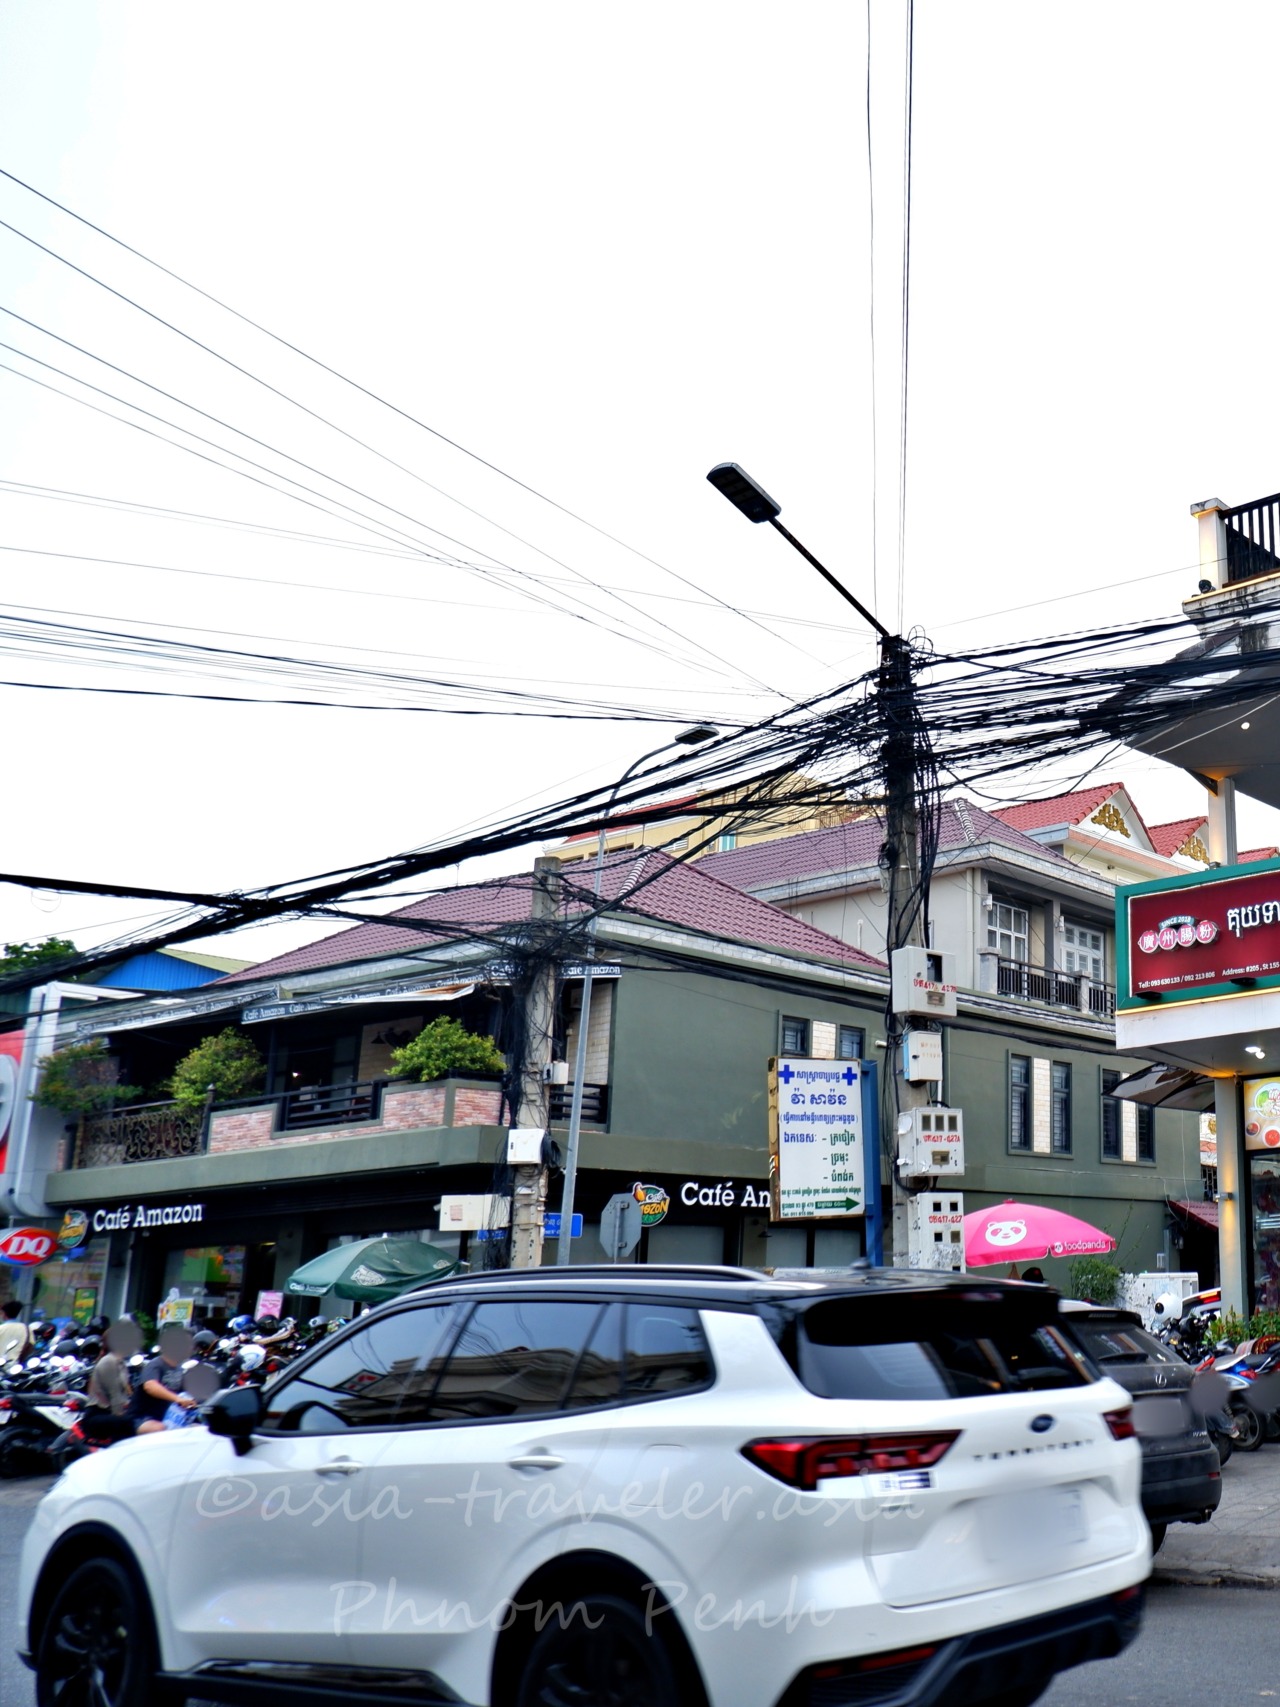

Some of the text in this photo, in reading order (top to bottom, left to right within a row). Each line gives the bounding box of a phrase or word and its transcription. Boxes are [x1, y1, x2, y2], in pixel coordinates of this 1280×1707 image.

[1222, 967, 1245, 976] Address:
[244, 1008, 259, 1021] Café
[259, 1006, 285, 1018] Amazon
[681, 1181, 735, 1206] Café
[93, 1205, 131, 1232] Café
[133, 1203, 203, 1229] Amazon
[7, 1235, 52, 1258] DQ
